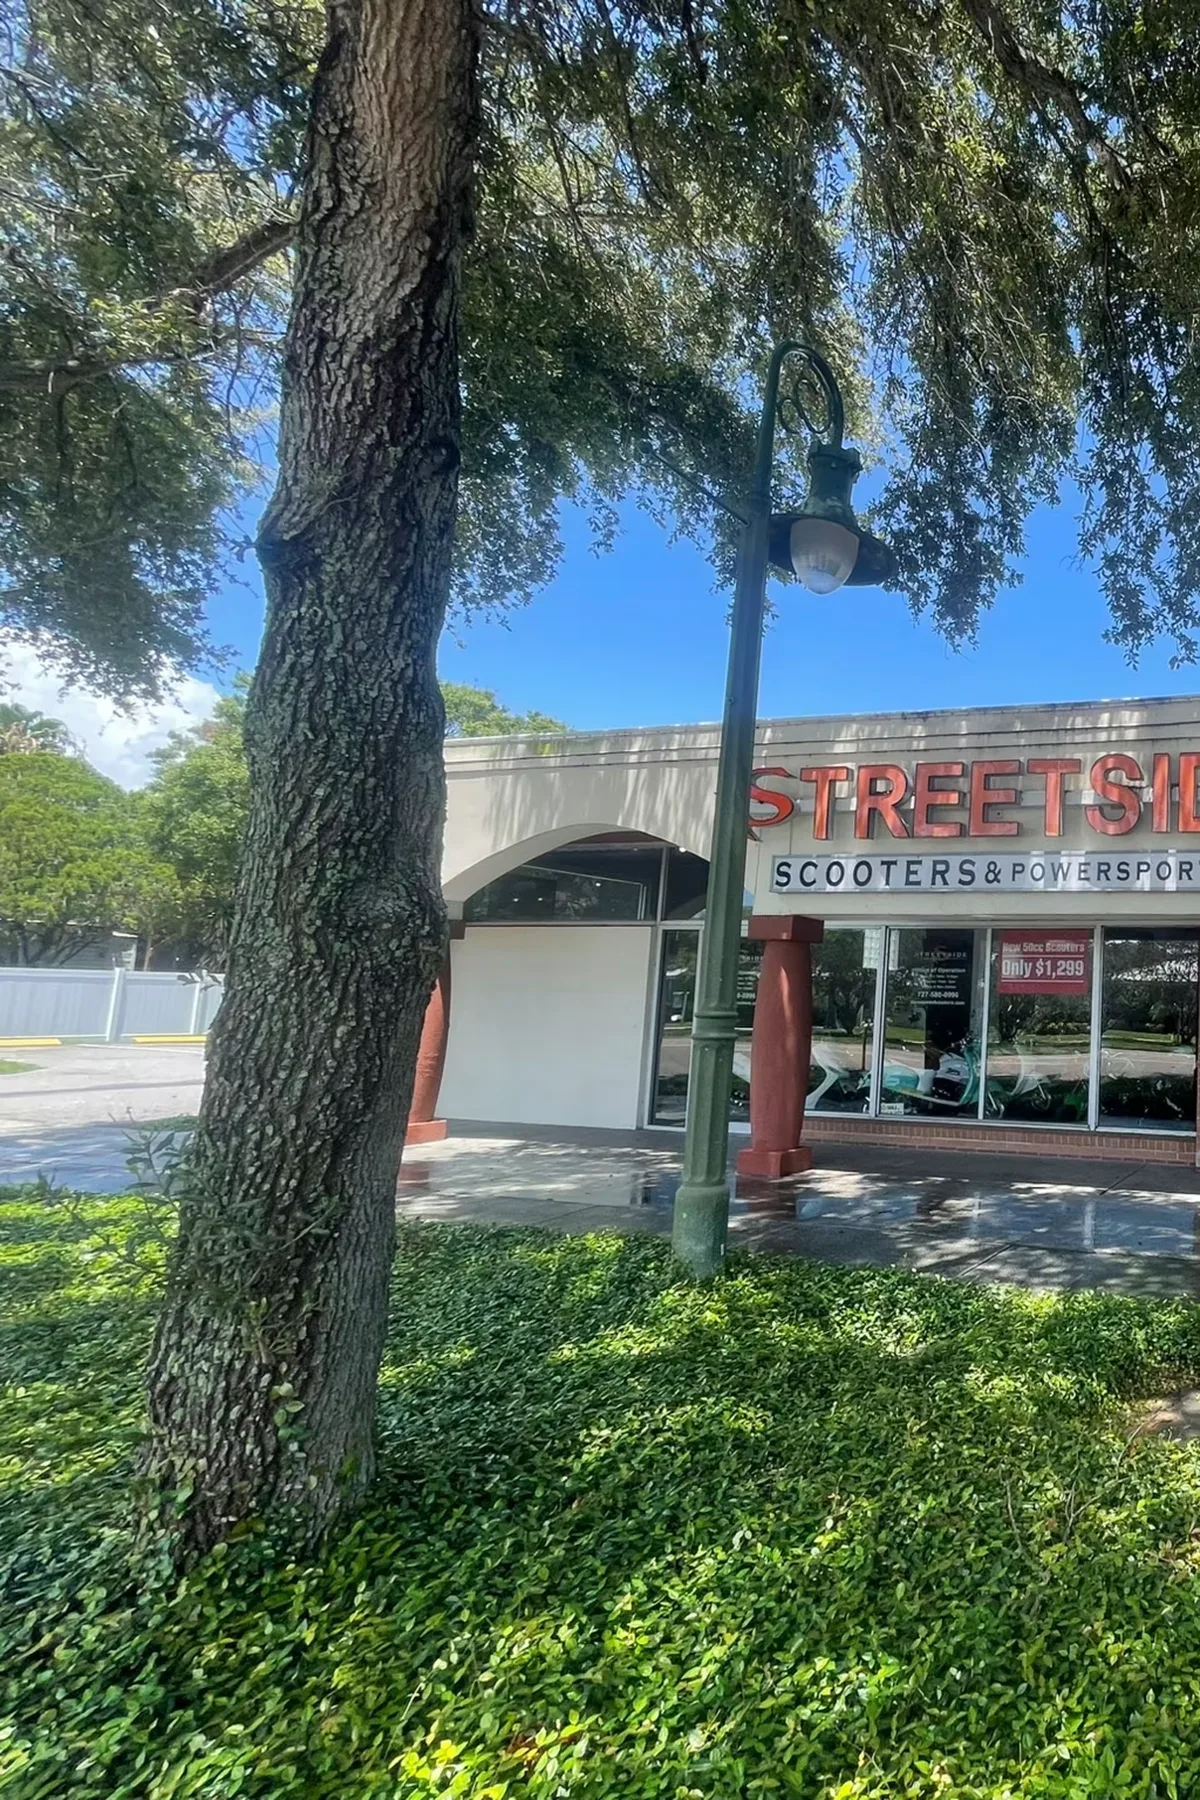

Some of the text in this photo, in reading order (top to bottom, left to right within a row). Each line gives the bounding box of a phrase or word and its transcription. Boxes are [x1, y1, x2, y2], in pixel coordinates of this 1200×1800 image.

[775, 858, 976, 887] SCOOTERS
[984, 860, 1002, 885] &
[1002, 942, 1085, 952] New 50cc Scooters
[1001, 958, 1085, 979] Only $1,299
